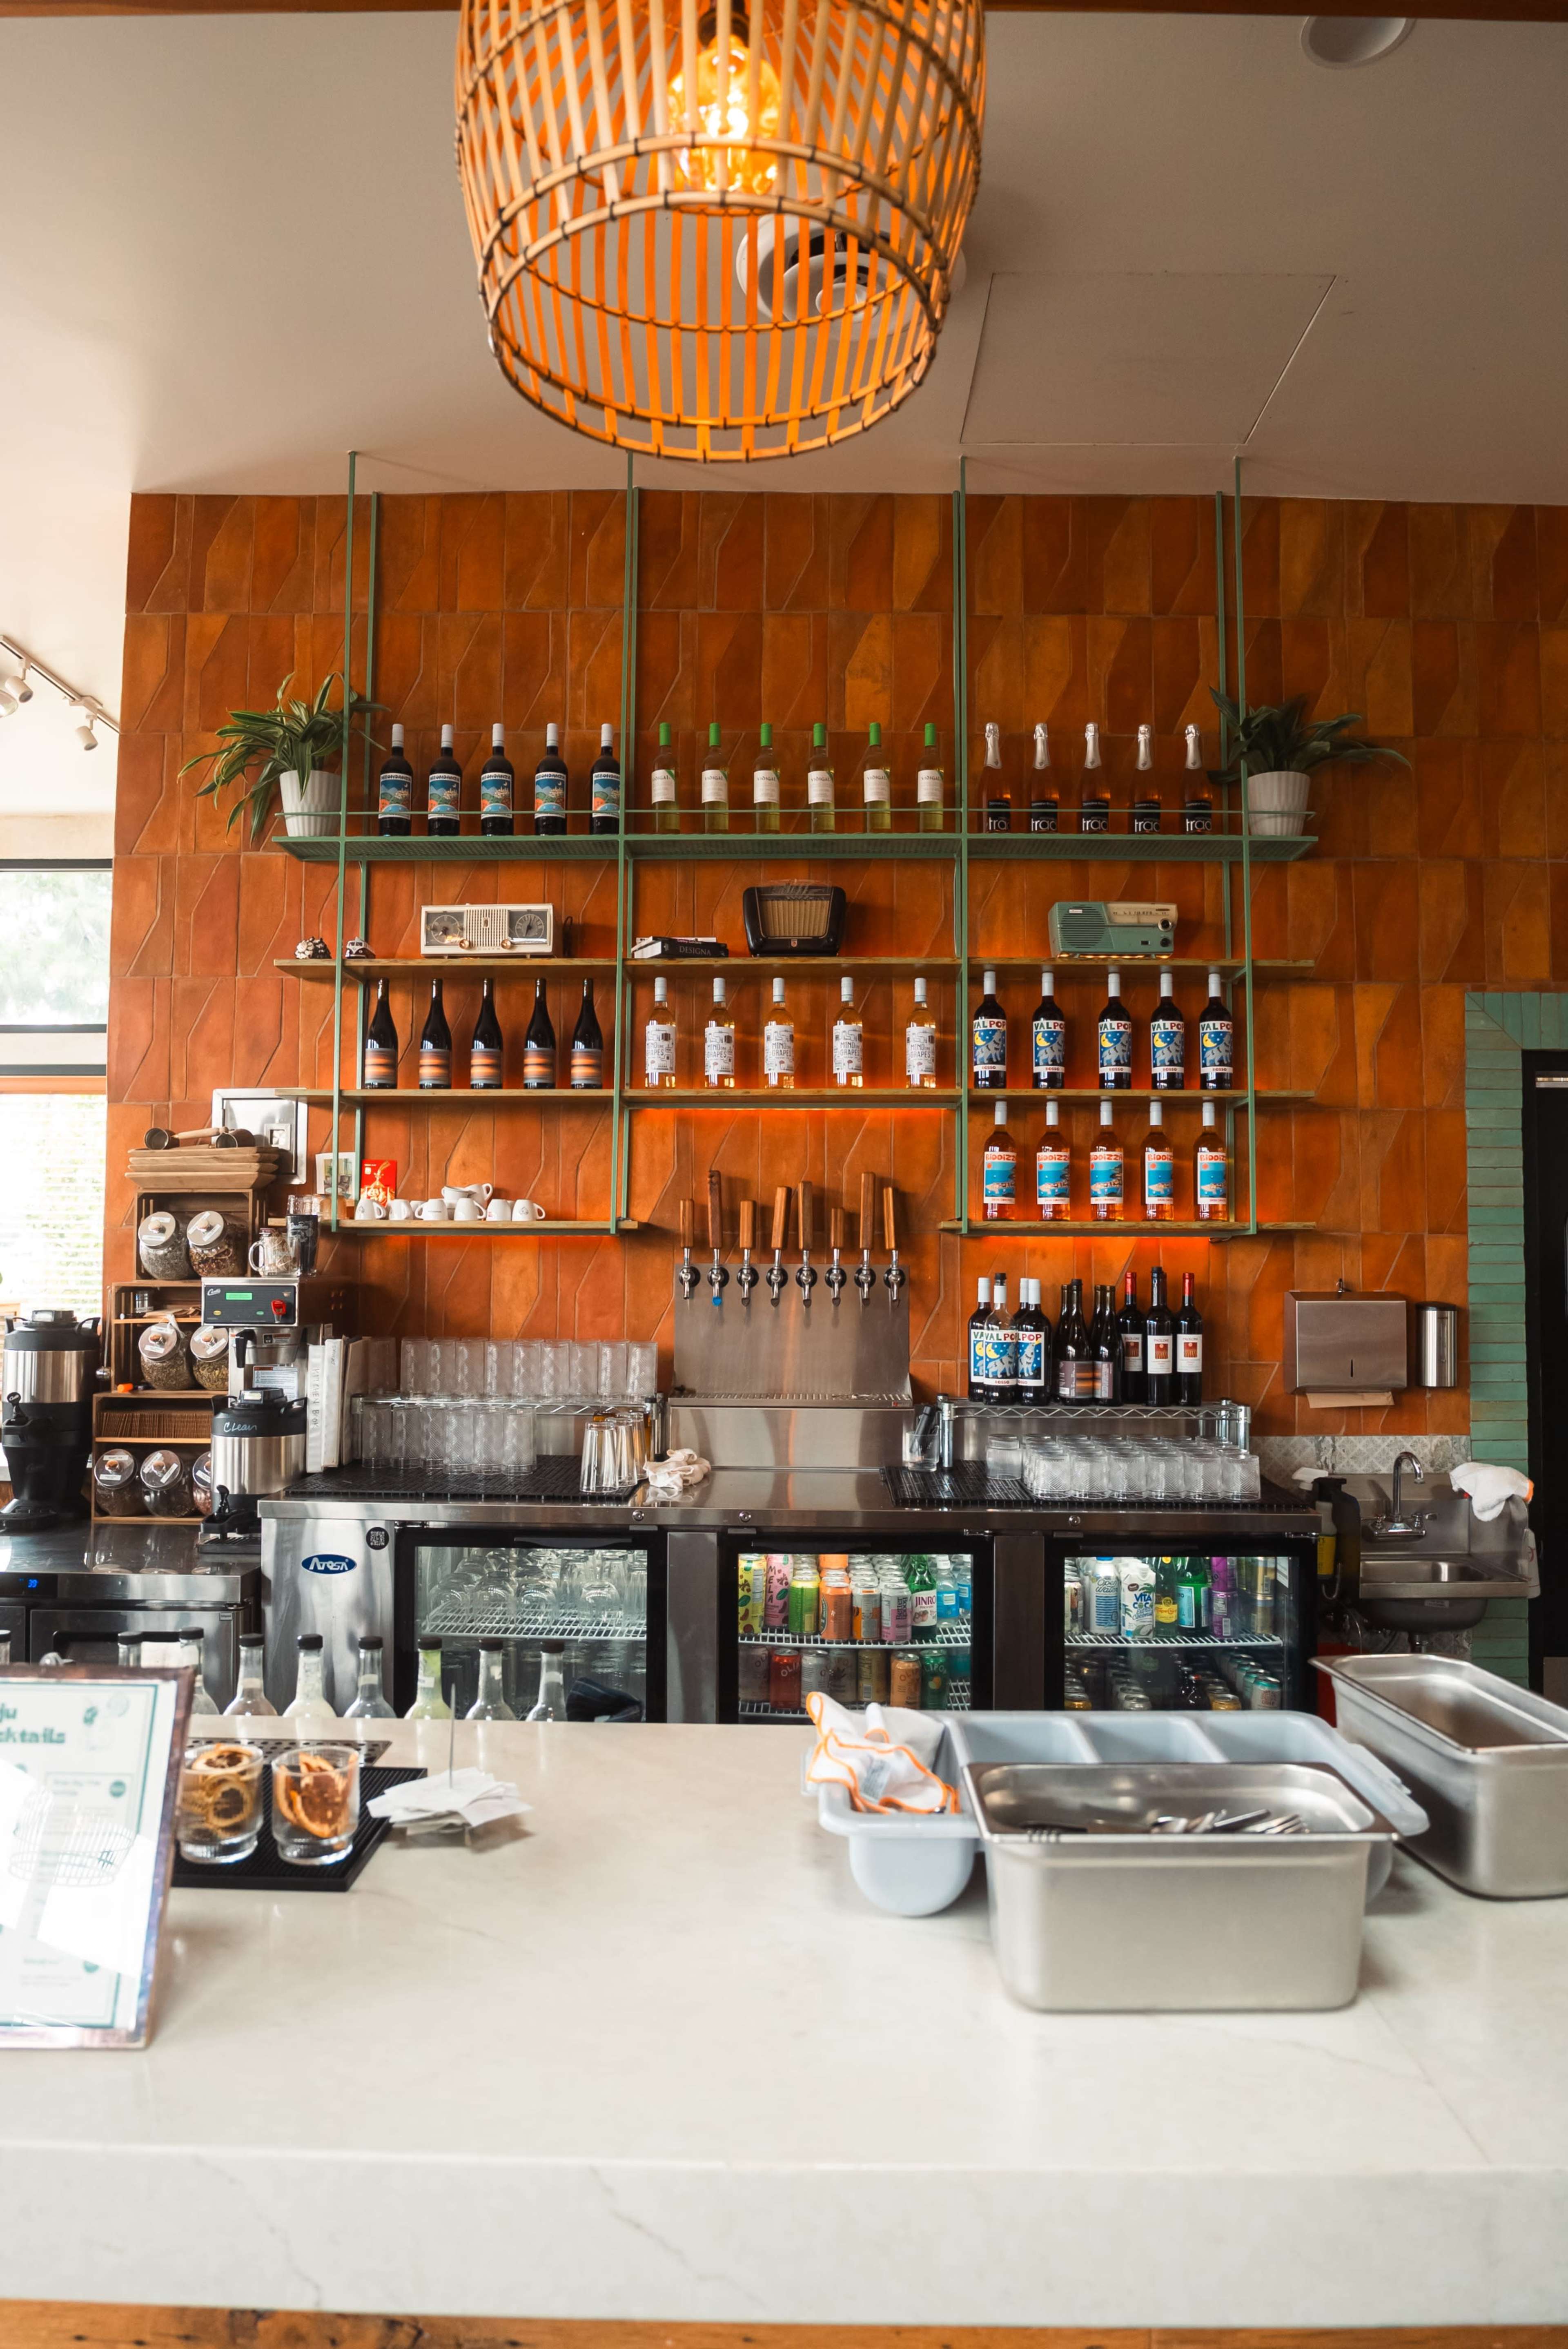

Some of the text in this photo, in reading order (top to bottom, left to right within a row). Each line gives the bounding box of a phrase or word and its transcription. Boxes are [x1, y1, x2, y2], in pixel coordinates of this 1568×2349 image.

[309, 1557, 348, 1570] ATOSA
[915, 1595, 936, 1607] JINRO
[1134, 1593, 1152, 1602] VITA
